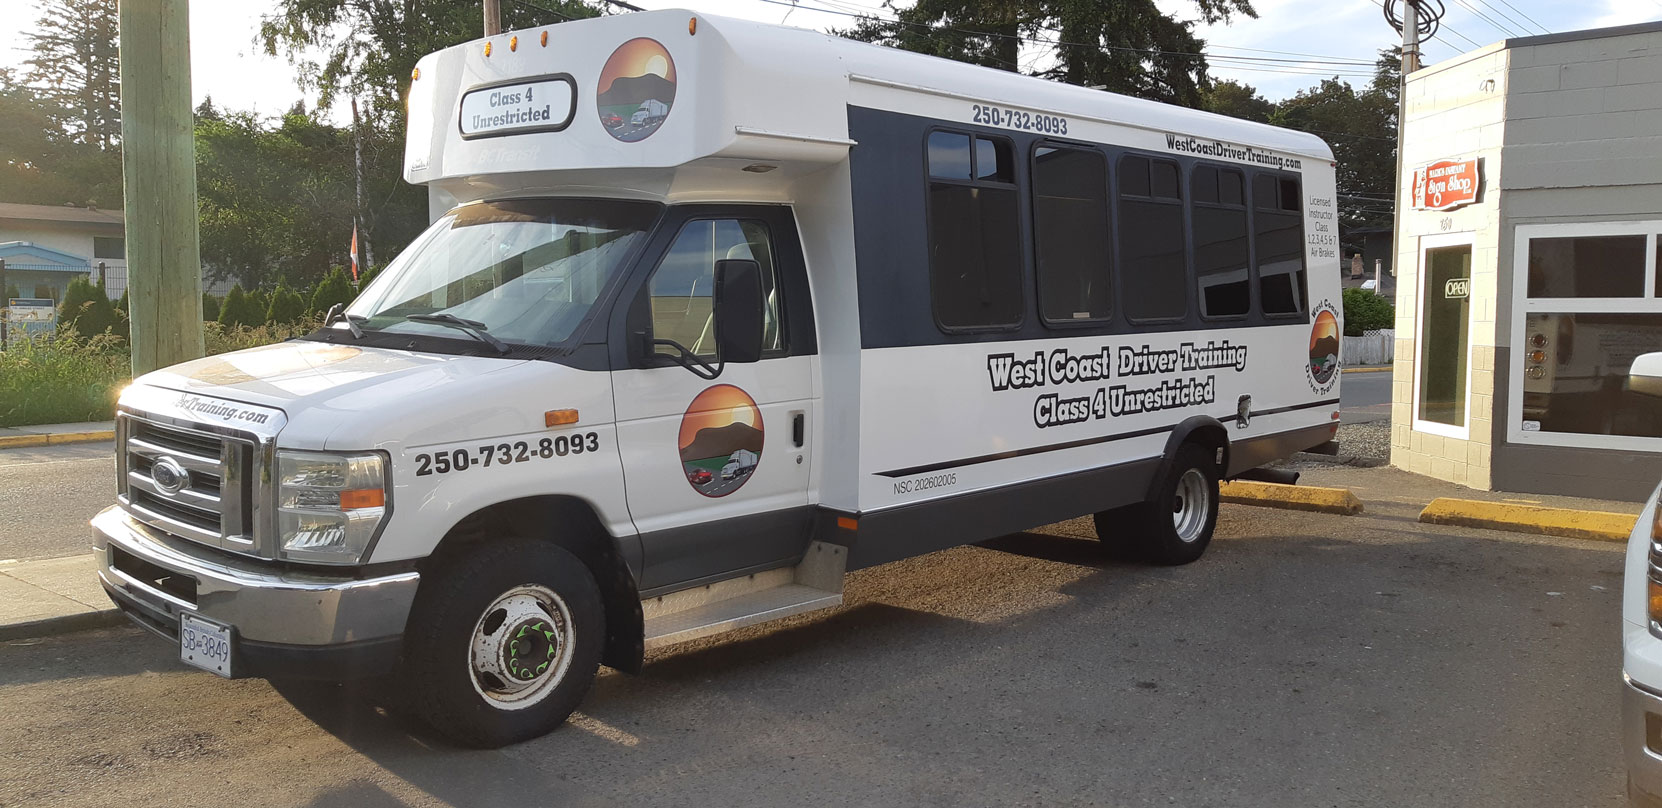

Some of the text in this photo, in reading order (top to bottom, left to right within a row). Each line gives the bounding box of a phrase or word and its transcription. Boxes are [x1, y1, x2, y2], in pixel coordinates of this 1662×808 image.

[489, 87, 533, 108] Class 4
[472, 104, 551, 130] Unrestricted
[972, 104, 1068, 136] 250-732-8093
[1165, 133, 1302, 170] WestCoastDriverTraining.com
[1310, 194, 1331, 207] Licensed
[1428, 175, 1471, 207] Sign Shop
[1308, 207, 1334, 220] Instructor
[1315, 221, 1329, 232] Class
[1319, 247, 1335, 258] Brakes
[1447, 281, 1468, 295] OPEN
[1311, 299, 1339, 319] West Coast
[987, 340, 1248, 392] West Coast Driver Training
[1305, 360, 1342, 396] Driver Training
[1034, 375, 1215, 428] Class 4 Unrestricted
[415, 431, 600, 477] 250-732-8093
[893, 472, 957, 495] NSC 202602005
[201, 634, 229, 663] 3849
